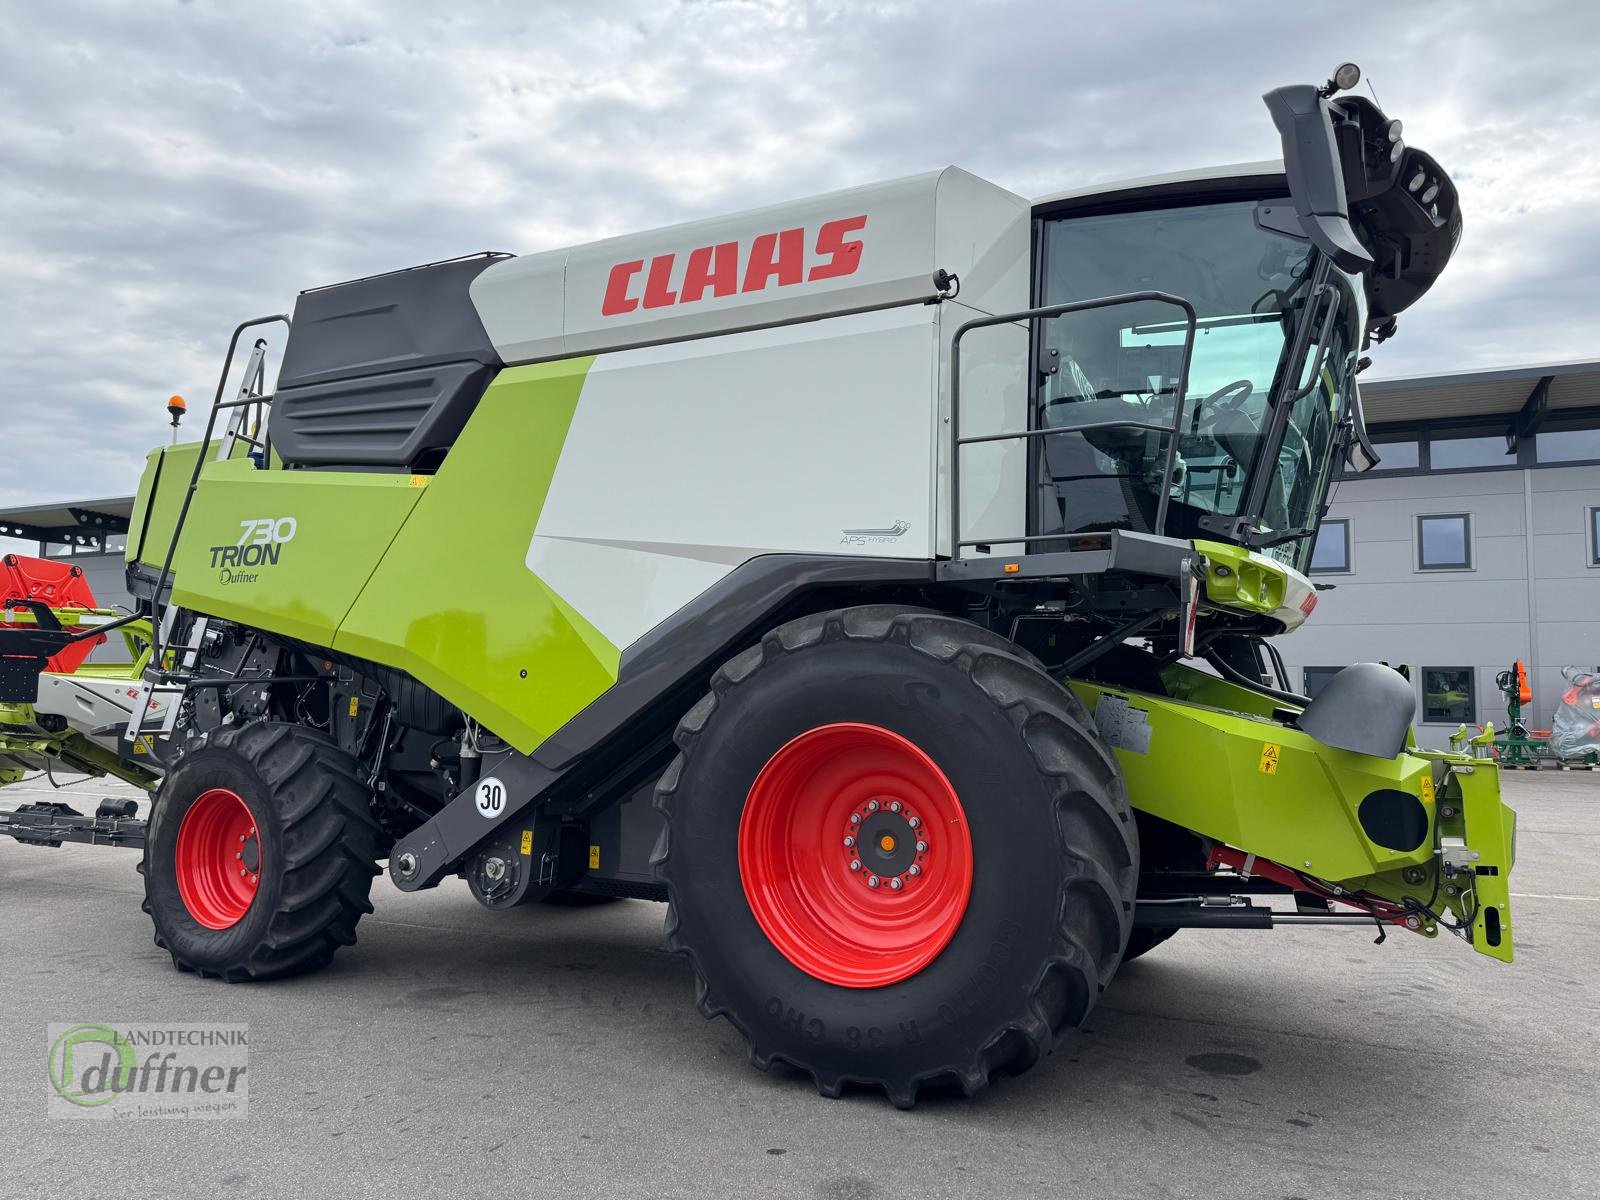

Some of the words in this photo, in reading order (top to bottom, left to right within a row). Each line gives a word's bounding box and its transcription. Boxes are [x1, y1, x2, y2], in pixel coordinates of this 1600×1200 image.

[602, 214, 868, 316] CLAAS
[237, 516, 297, 545] 730
[210, 543, 282, 568] TRION
[220, 568, 259, 585] Duffner
[480, 784, 502, 811] 30
